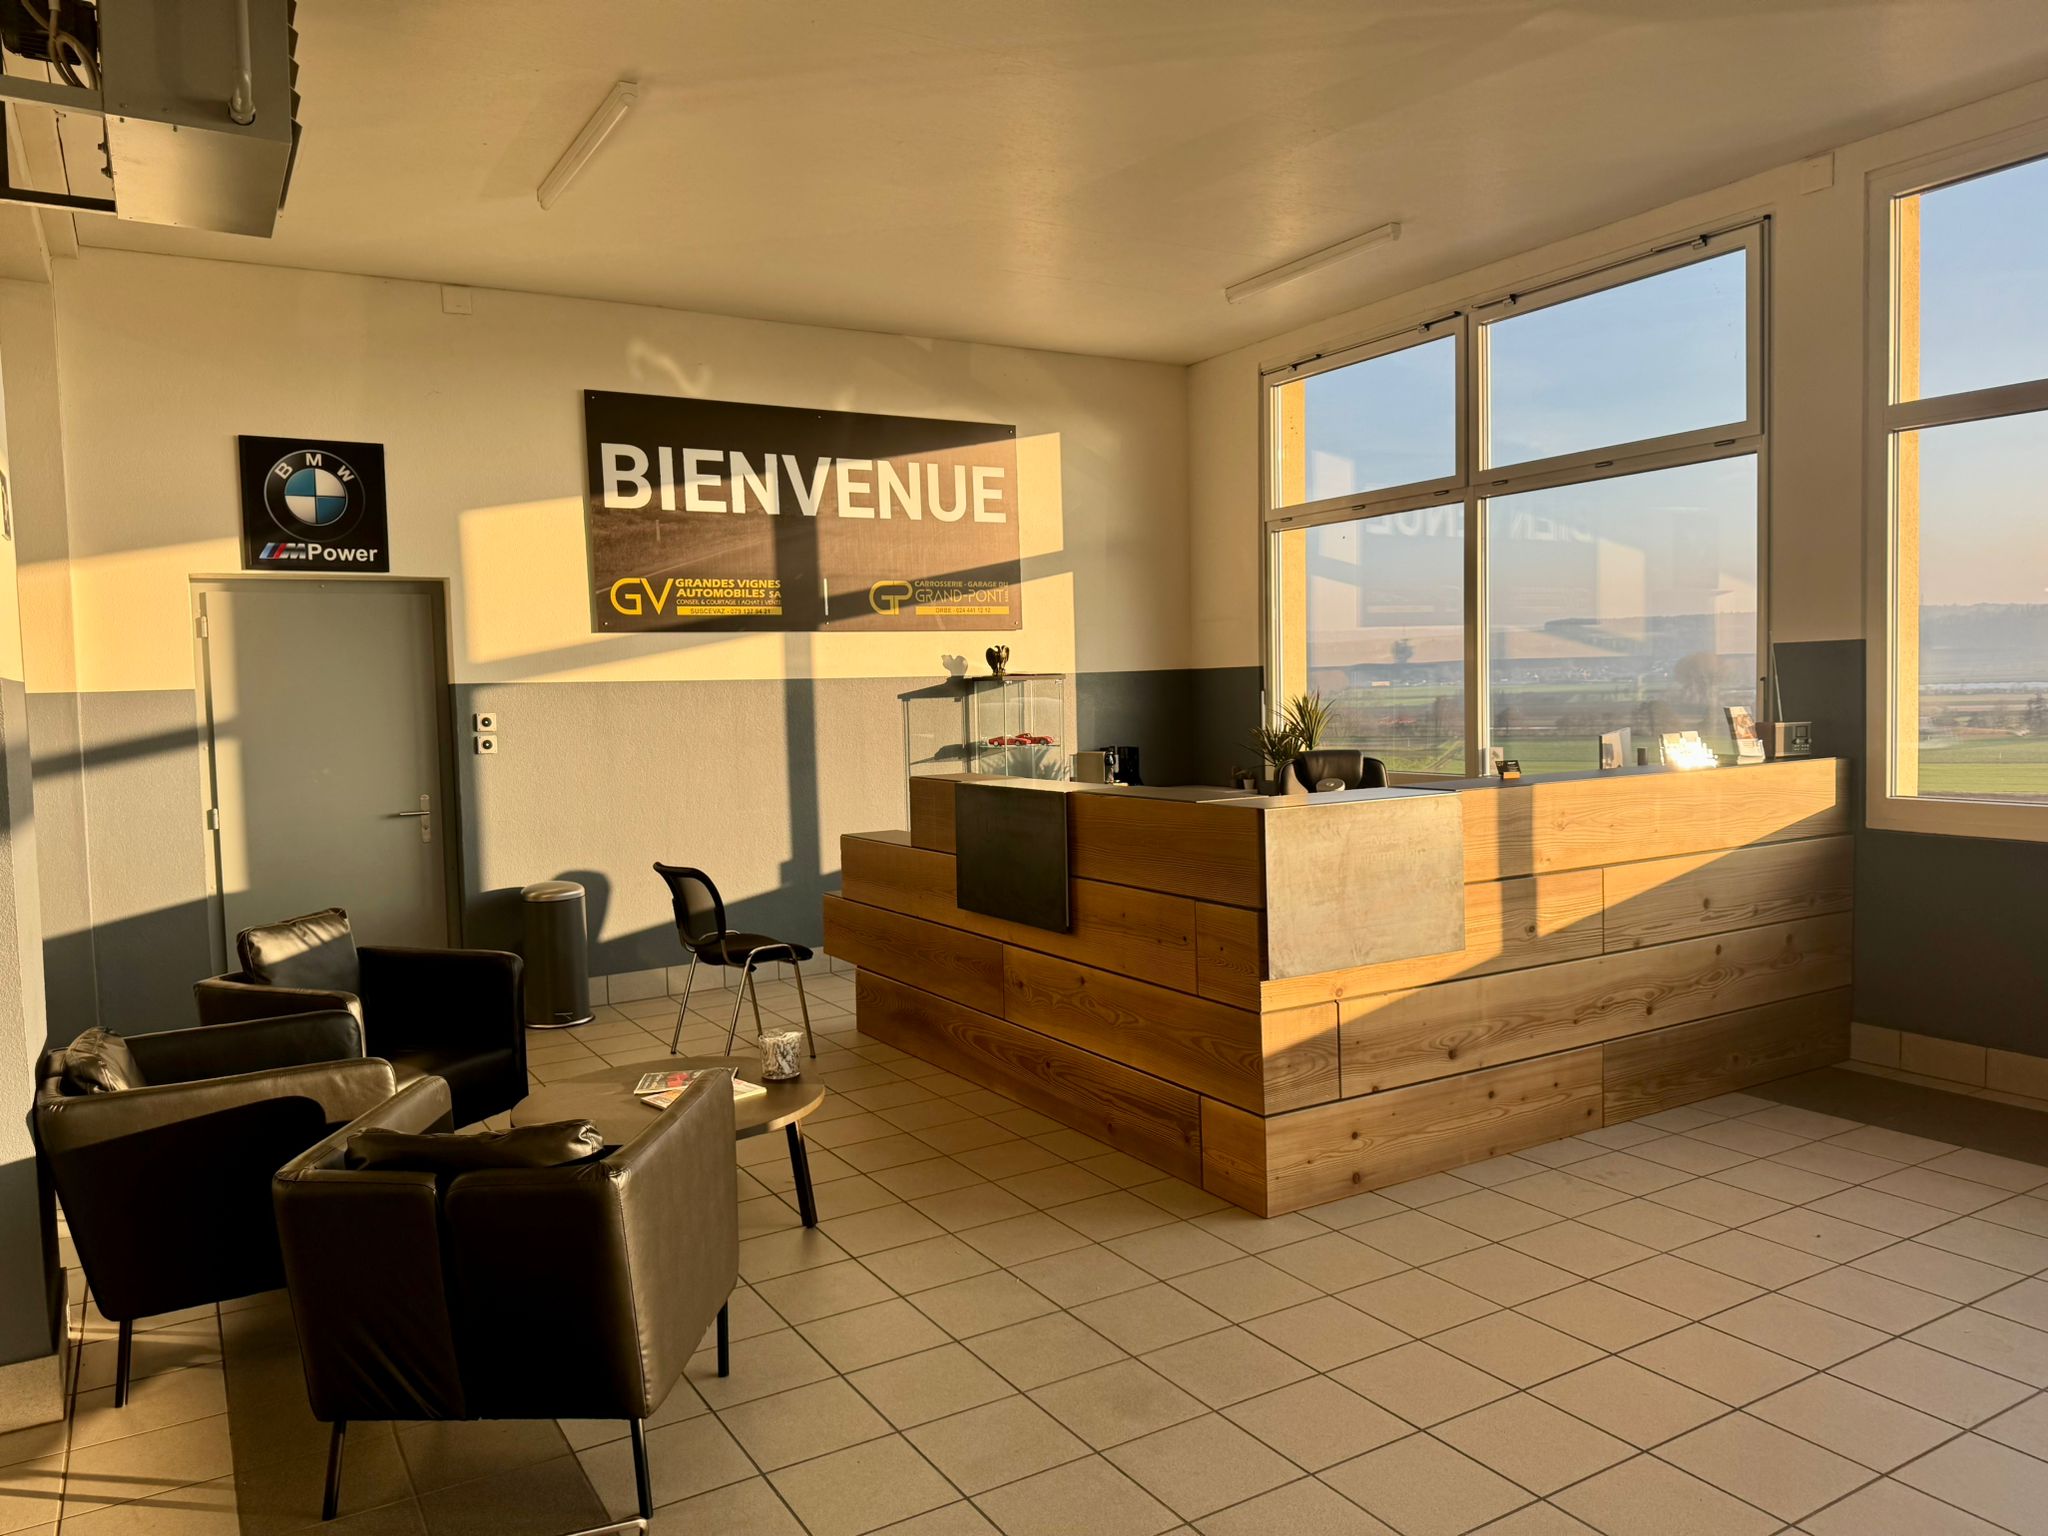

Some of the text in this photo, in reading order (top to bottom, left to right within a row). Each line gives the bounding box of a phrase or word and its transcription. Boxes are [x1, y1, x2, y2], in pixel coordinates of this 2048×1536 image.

[274, 452, 355, 483] BMW
[601, 442, 1007, 524] BIENVENUE
[675, 578, 781, 589] GRANDES VIGNES
[914, 580, 963, 588] CARROSSERIE
[610, 577, 674, 616] GV
[676, 588, 782, 599] AUTOMOBILES SA
[915, 589, 1005, 603] GRAND-PONT
